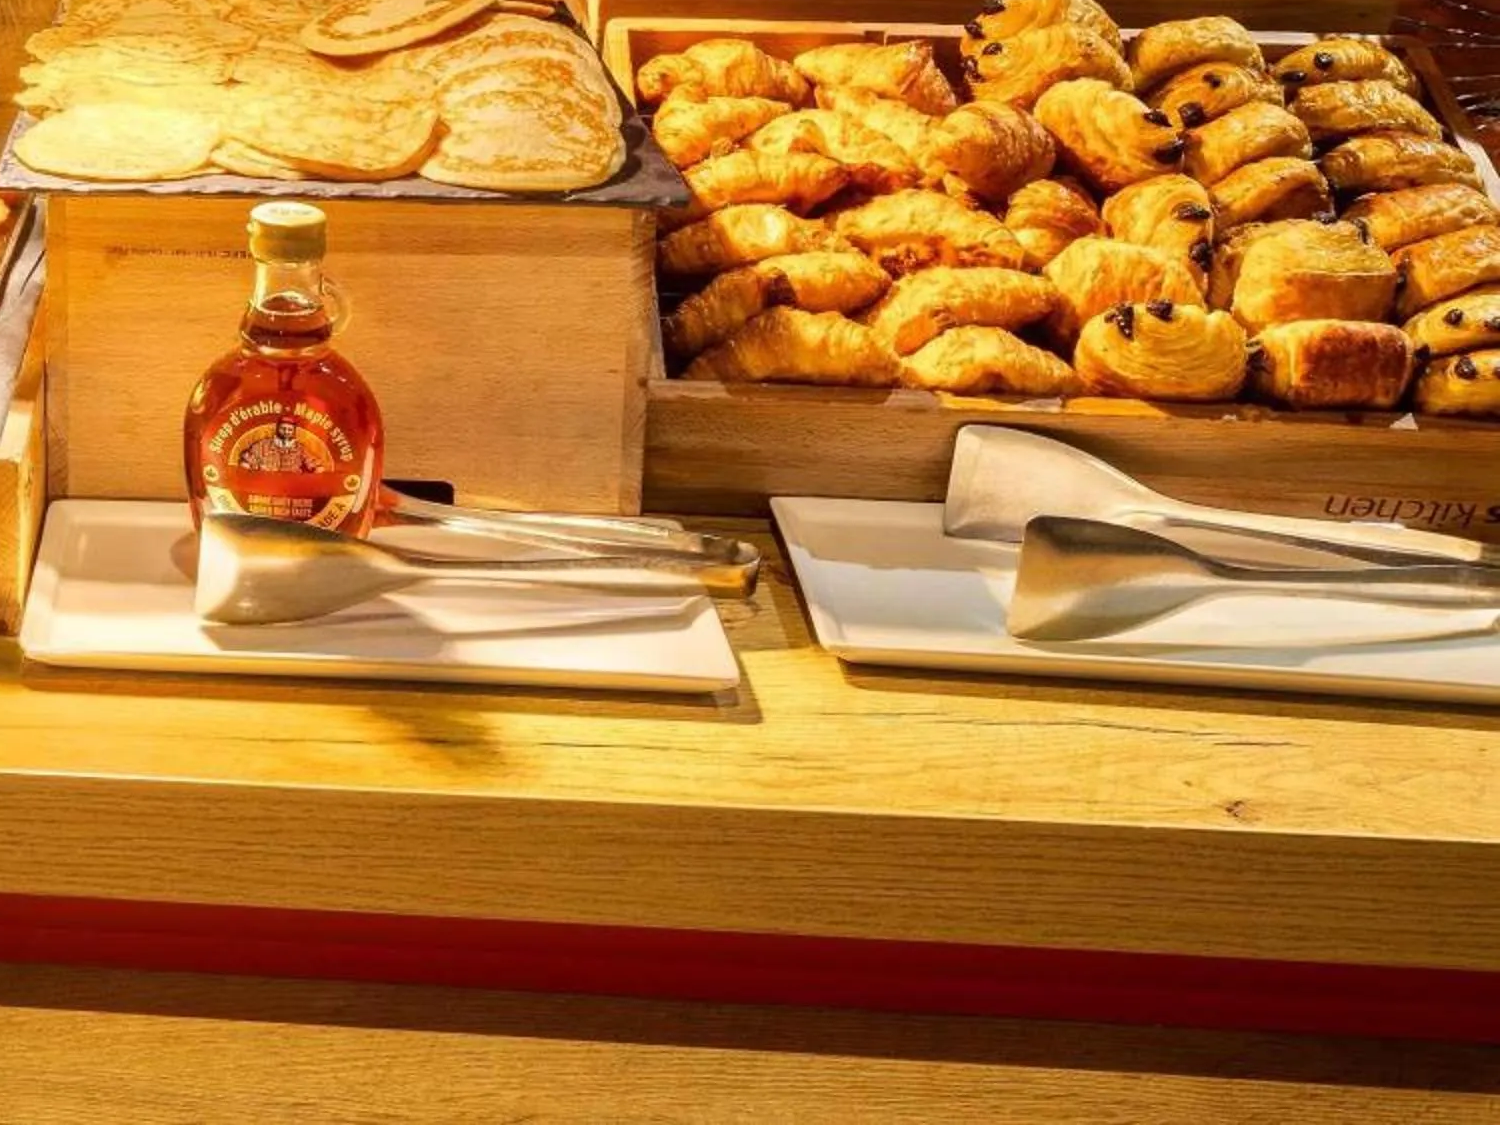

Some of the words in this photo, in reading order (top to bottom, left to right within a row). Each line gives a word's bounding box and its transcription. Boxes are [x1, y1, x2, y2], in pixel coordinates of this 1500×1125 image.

[208, 423, 234, 454] Sirop
[293, 402, 331, 430] Maple
[1325, 494, 1478, 528] kitchen
